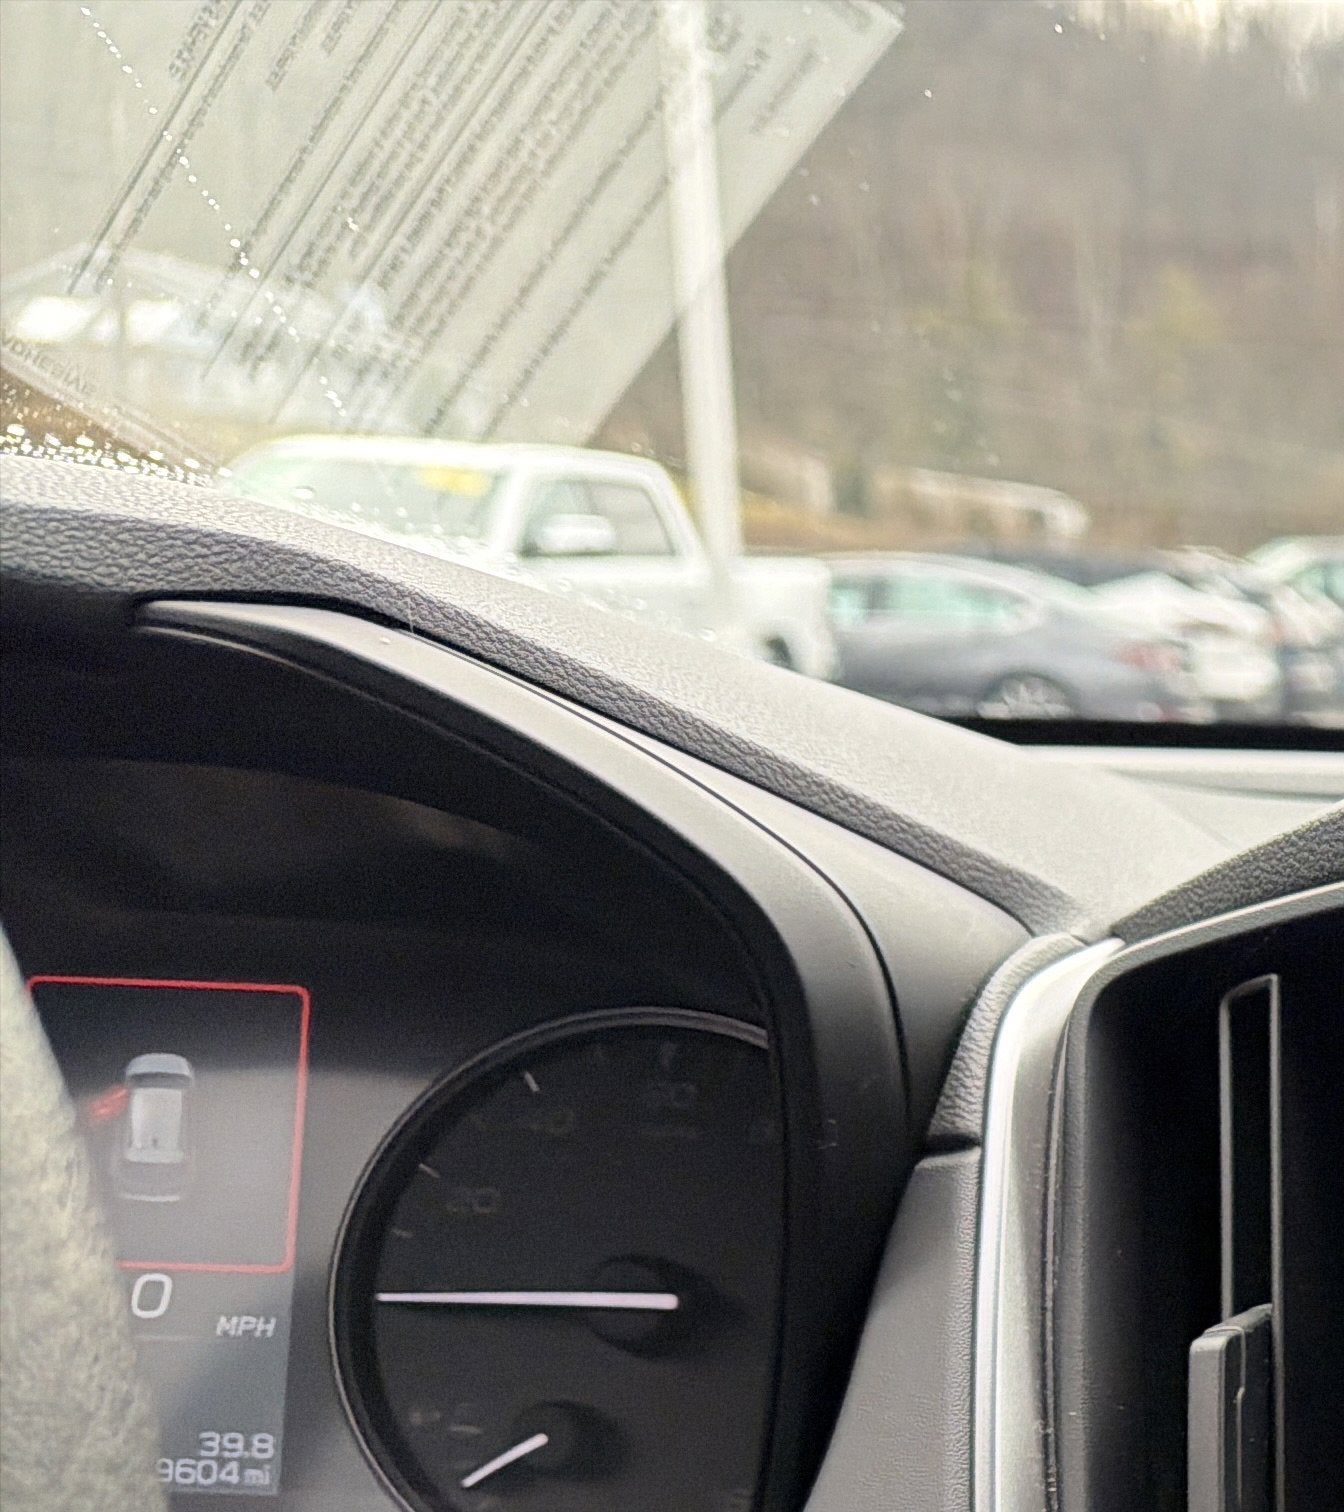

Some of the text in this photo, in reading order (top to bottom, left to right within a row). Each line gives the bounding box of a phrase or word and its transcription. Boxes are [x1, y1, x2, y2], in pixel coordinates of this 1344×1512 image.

[131, 1273, 173, 1319] 0
[214, 1313, 277, 1338] MPH
[199, 1430, 276, 1460] 39.8
